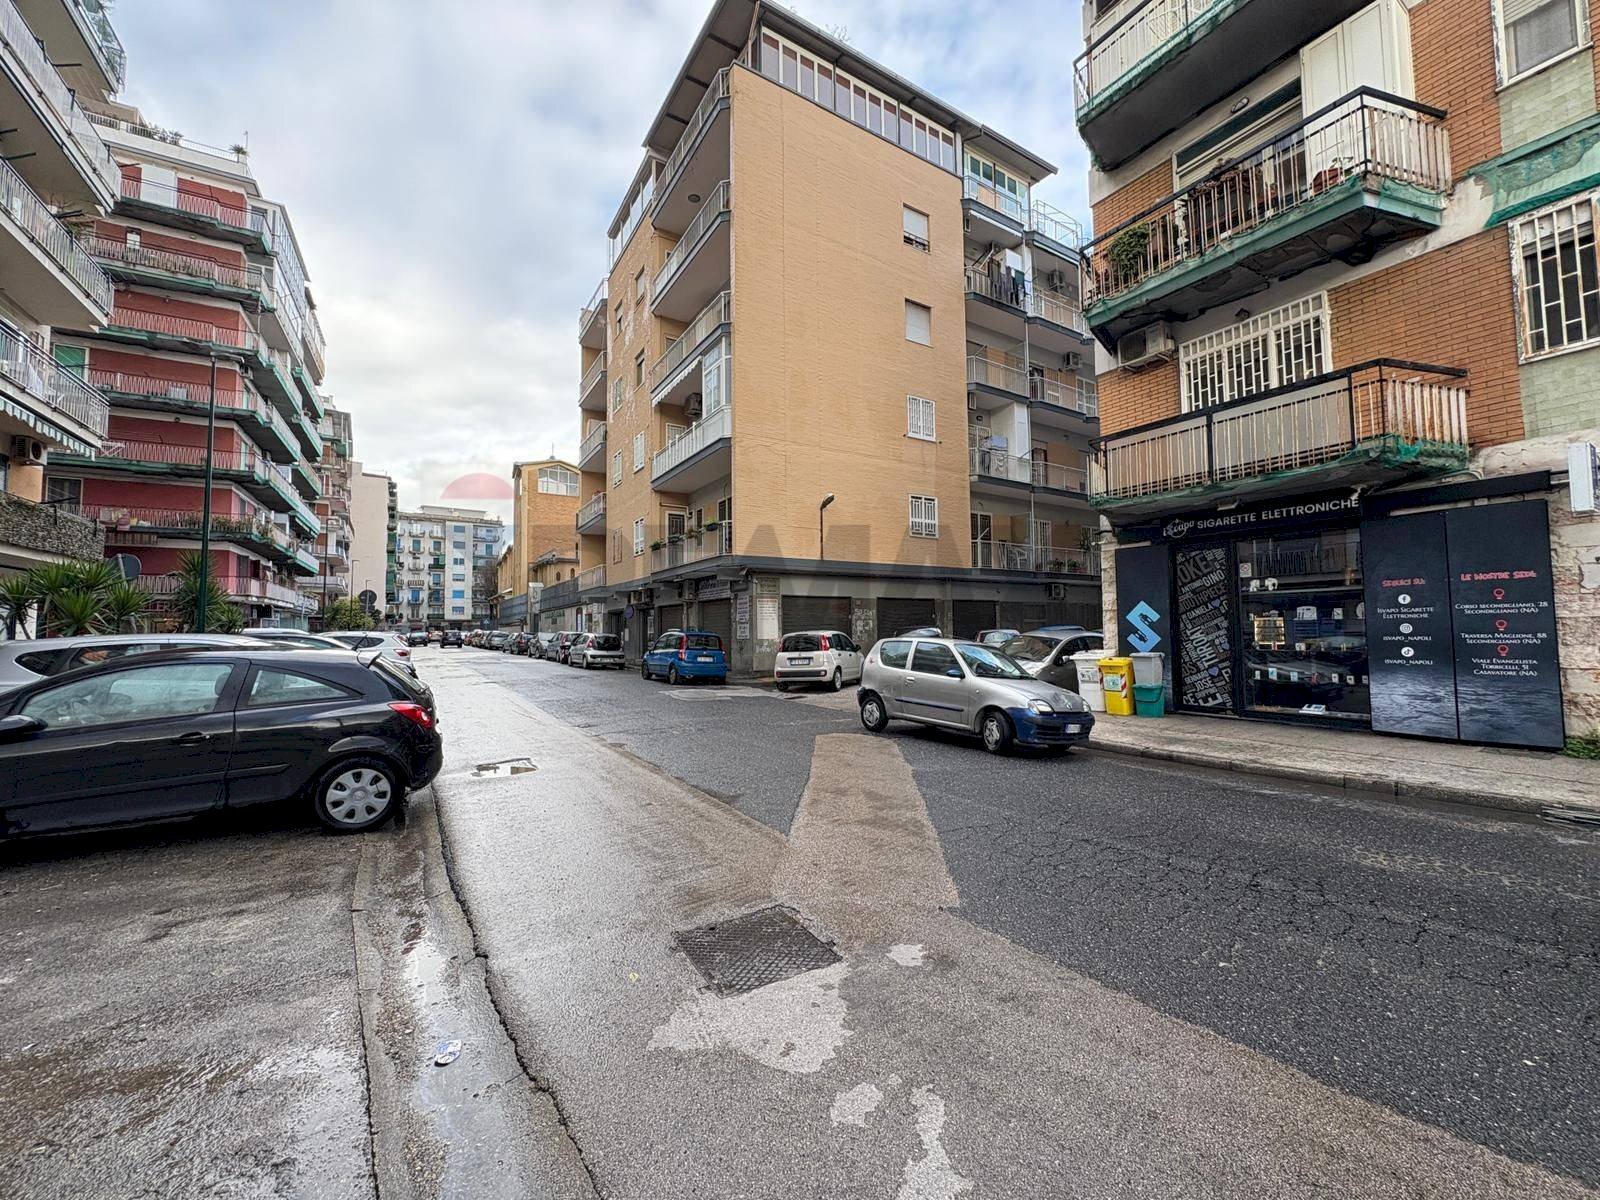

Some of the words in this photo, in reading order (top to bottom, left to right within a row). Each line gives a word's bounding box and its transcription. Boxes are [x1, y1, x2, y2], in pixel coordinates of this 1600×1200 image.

[1197, 512, 1257, 529] SIGARETTE
[1261, 499, 1359, 520] ELETTRONICHE
[1202, 569, 1225, 587] GINO
[1461, 573, 1472, 581] LE
[1185, 626, 1219, 668] THROAT
[1194, 676, 1215, 691] JOSE
